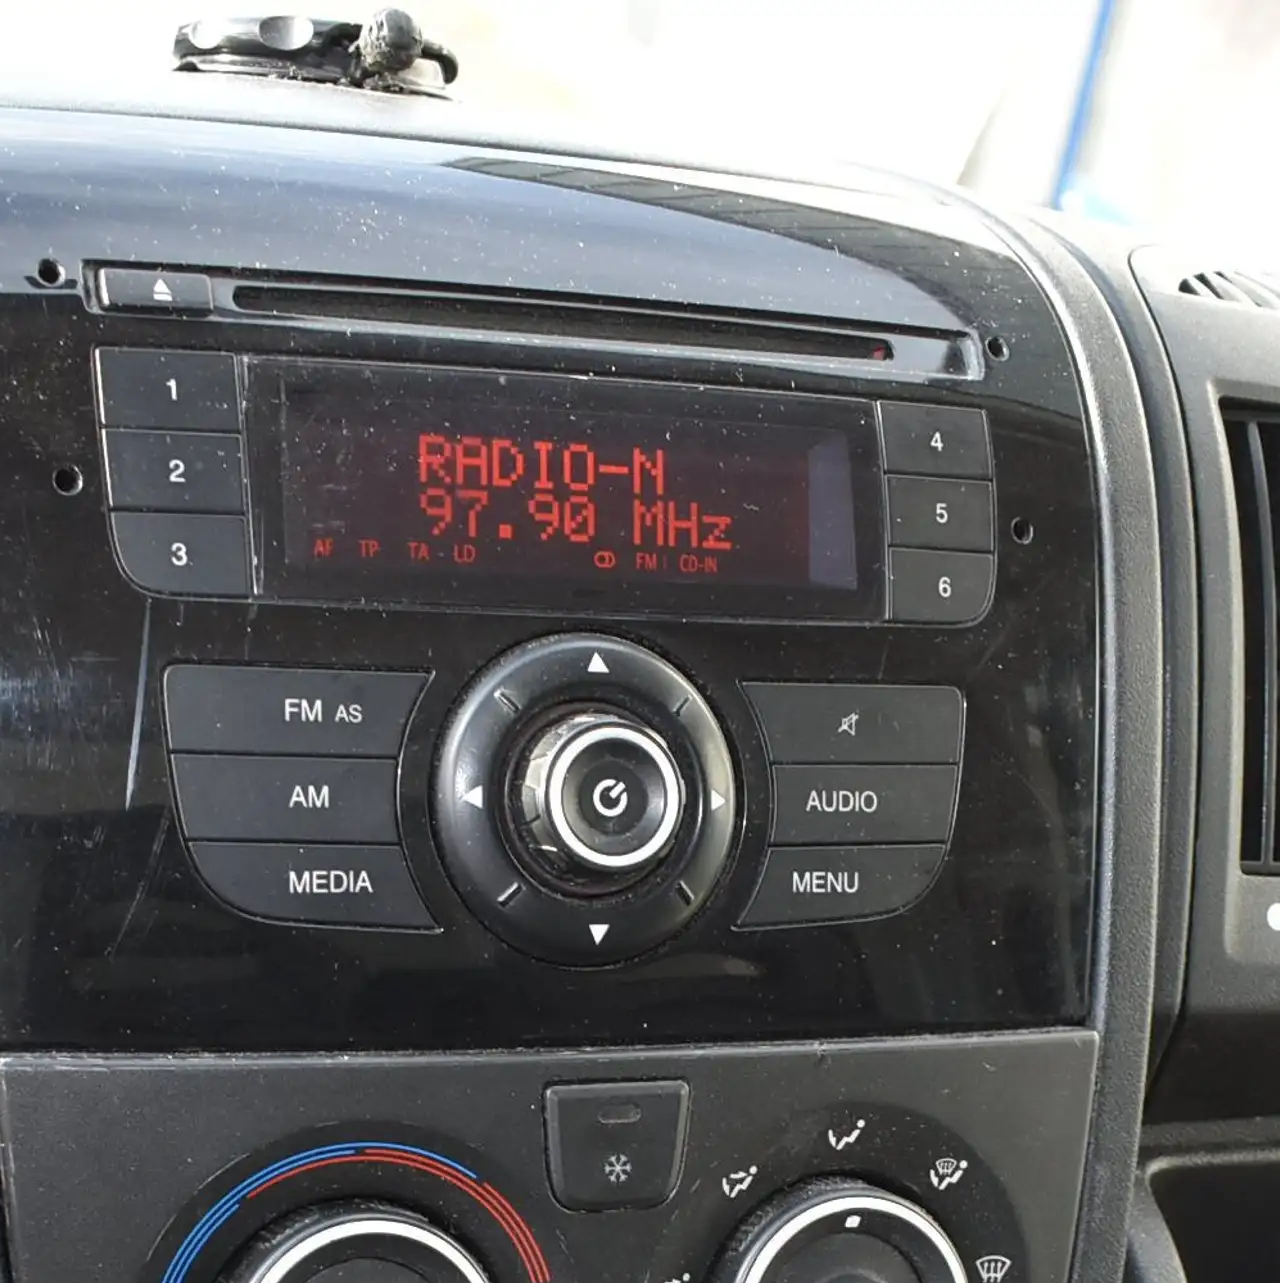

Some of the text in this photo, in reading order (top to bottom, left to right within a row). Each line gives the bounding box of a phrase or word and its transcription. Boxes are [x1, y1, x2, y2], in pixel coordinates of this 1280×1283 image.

[166, 377, 178, 400] 1
[929, 430, 945, 452] 4
[168, 458, 187, 484] 2
[420, 435, 664, 494] RADIO-N
[421, 487, 732, 550] 97.90 MHz
[935, 503, 949, 525] 5
[170, 542, 189, 567] 3
[313, 538, 334, 557] AF
[358, 538, 381, 557] TP
[408, 541, 430, 560] TA
[937, 575, 952, 599] 6
[283, 698, 364, 724] FM AS
[288, 784, 331, 809] AM
[805, 789, 879, 814] AUDIO
[288, 869, 374, 895] MEDIA
[791, 870, 860, 894] MENU
